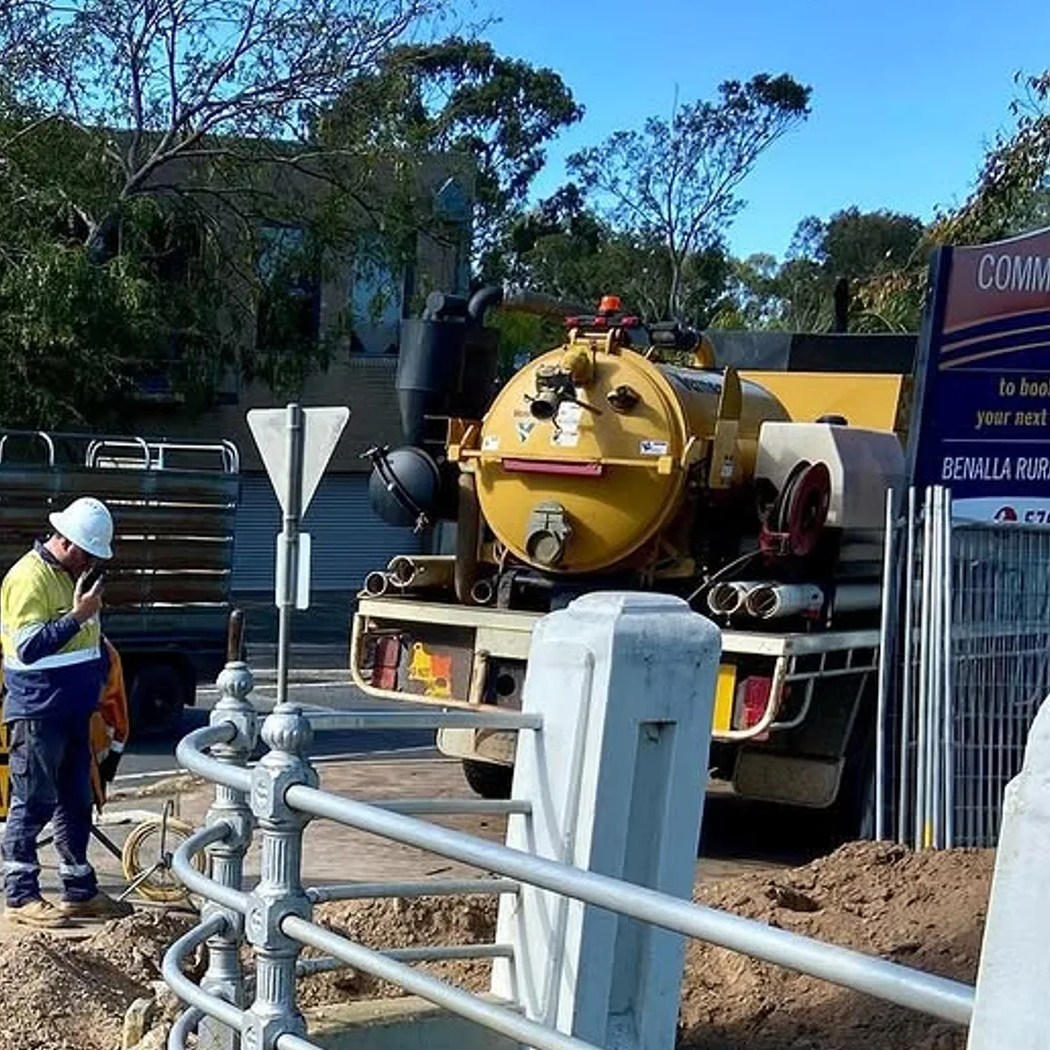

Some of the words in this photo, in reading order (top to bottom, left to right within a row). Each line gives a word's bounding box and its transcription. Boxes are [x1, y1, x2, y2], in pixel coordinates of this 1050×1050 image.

[999, 377, 1016, 396] to
[1020, 377, 1050, 396] boo
[974, 410, 1011, 429] your
[1014, 408, 1047, 426] next
[942, 456, 1011, 480] BENALLA
[1016, 456, 1050, 480] RUR
